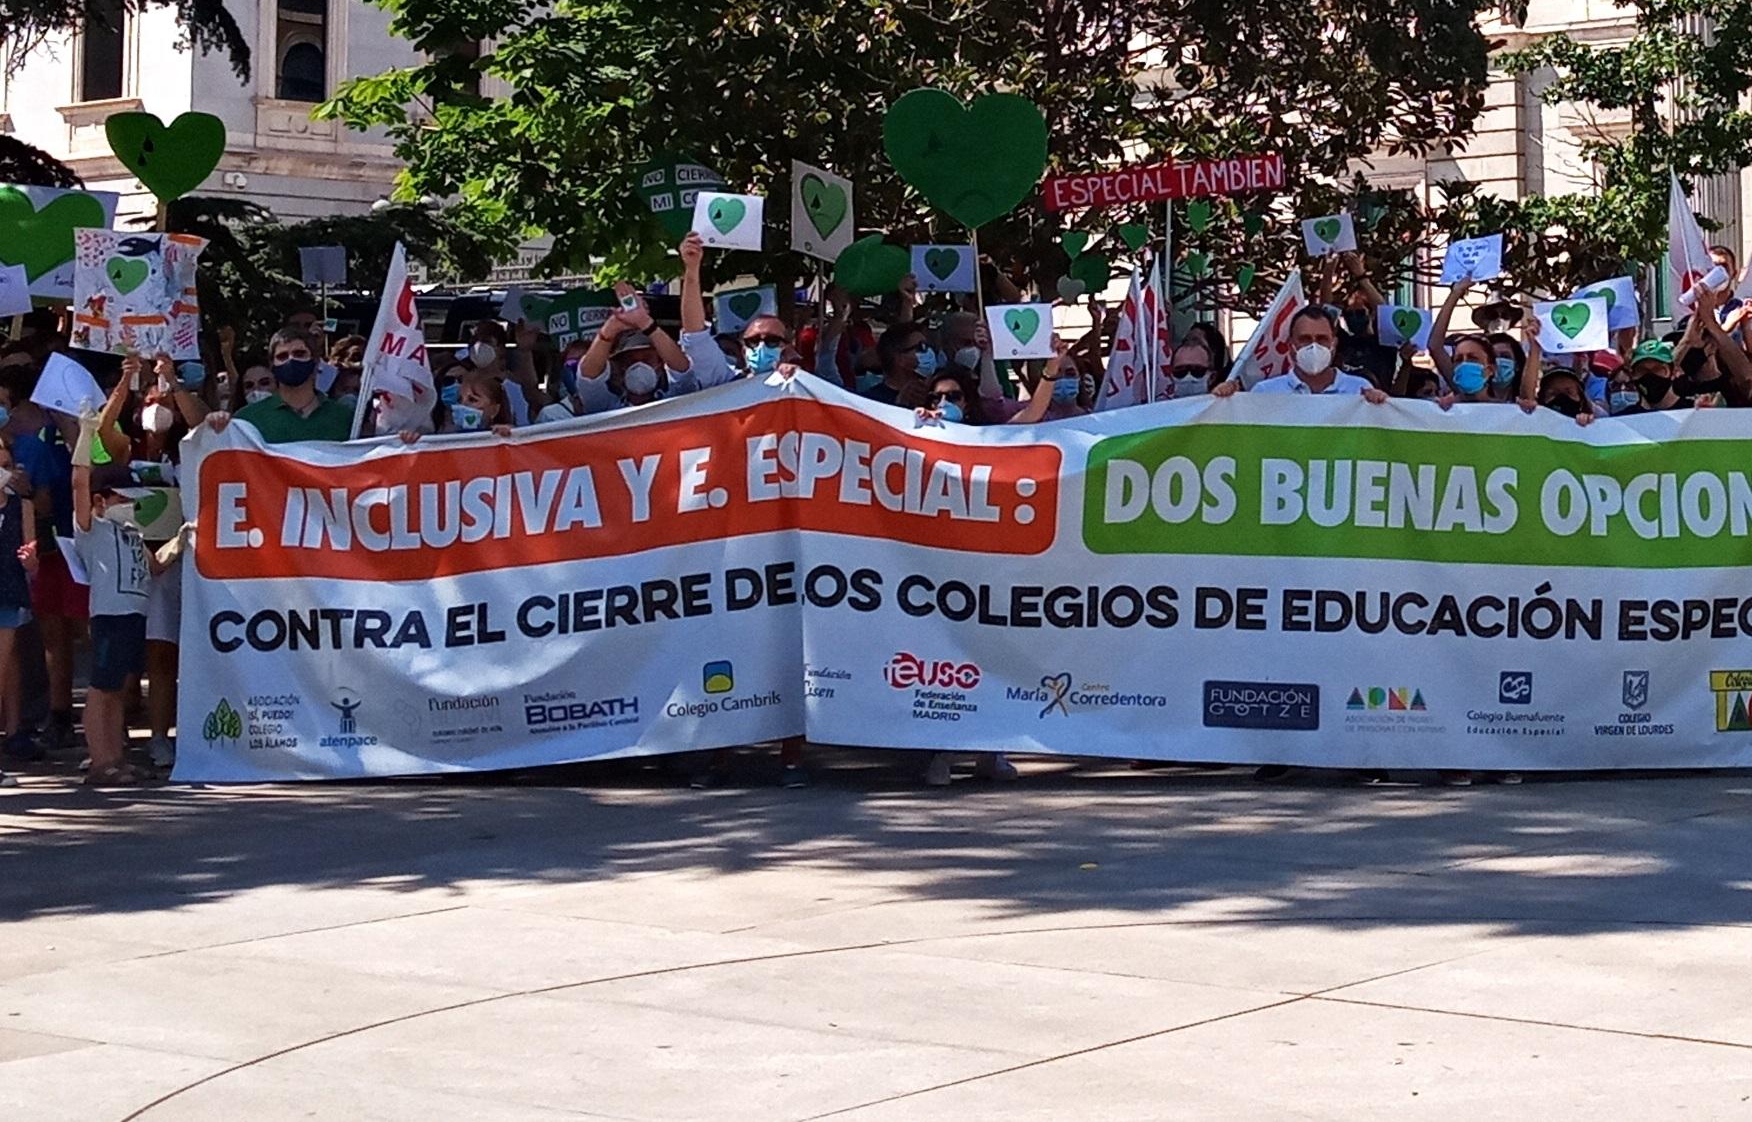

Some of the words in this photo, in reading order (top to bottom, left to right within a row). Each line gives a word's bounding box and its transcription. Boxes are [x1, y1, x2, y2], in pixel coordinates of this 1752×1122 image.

[644, 171, 663, 185] NO
[1053, 169, 1172, 207] ESPECIAL
[1172, 155, 1283, 197] TAMBIEN
[652, 195, 671, 209] MI
[551, 314, 567, 328] NO
[215, 482, 264, 549] E.
[280, 466, 603, 552] INCLUSIVA
[616, 453, 662, 523] Y
[677, 447, 729, 514] E.
[1103, 456, 1237, 524] DOS
[1260, 458, 1519, 534] BUENAS
[209, 608, 431, 653] CONTRA
[445, 603, 506, 648] EL
[516, 573, 713, 639] CIERRE
[725, 562, 798, 612] DE
[801, 564, 883, 612] OS
[897, 575, 1179, 629] COLEGIOS
[1194, 586, 1268, 630] DE
[1281, 581, 1603, 640] EDUCACIÓN
[428, 694, 500, 711] Fundación
[914, 689, 966, 702] Federación
[1069, 692, 1167, 707] Corredentora
[1210, 688, 1311, 704] FUNDACIÓN
[525, 696, 639, 726] BOBATH
[666, 700, 719, 718] Colegio
[721, 691, 782, 712] Cambrils
[913, 700, 926, 709] de
[928, 700, 978, 712] Enseñanza
[912, 710, 961, 721] MADRID
[1466, 710, 1503, 723] Colegio
[1505, 710, 1565, 723] Buenafuente
[1618, 713, 1652, 723] COLEGIO
[1467, 726, 1518, 735] Educación
[1523, 727, 1565, 736] Especial
[1594, 725, 1625, 736] VIRGEN
[1626, 724, 1637, 735] DE
[1637, 724, 1674, 735] LOURDES
[319, 734, 378, 748] atenpace
